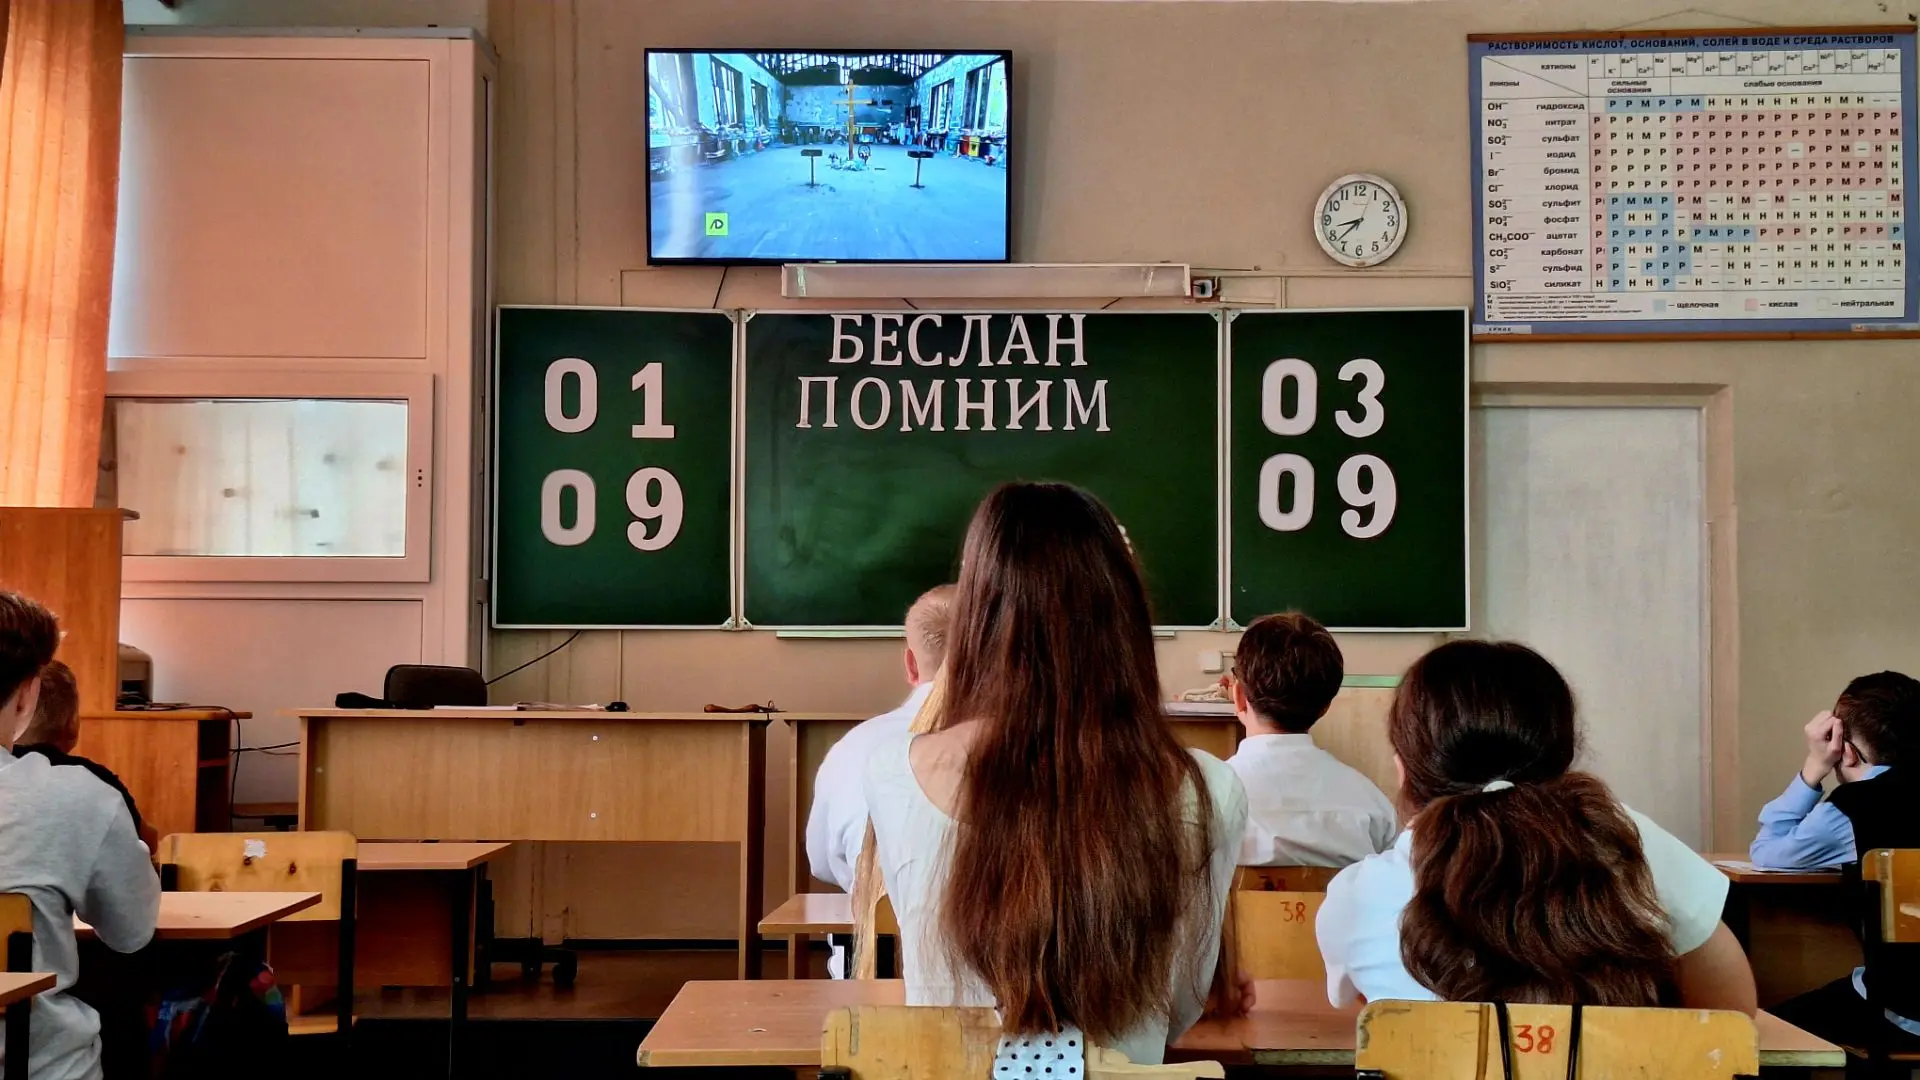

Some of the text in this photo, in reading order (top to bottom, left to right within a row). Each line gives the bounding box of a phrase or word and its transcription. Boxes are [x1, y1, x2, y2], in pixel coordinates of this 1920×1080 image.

[1488, 42, 1579, 50] РАСТВОРИМОСТЬ
[1703, 36, 1738, 46] СОЛЕЙ
[1752, 37, 1780, 46] ВОДЕ
[1784, 37, 1790, 45] И
[1793, 36, 1828, 45] СРЕДА
[1831, 36, 1894, 44] РАСТВОРОВ
[1536, 103, 1585, 111] гидроксид
[1609, 96, 1864, 108] Р Р М Р Р М Н Н Н Н Н Н Н Н М Н
[1593, 112, 1898, 124] Р Р Р Р Р Р Р Р Р Р Р Р Р Р Р Р Р Р Р
[1542, 135, 1580, 144] сульфат
[1594, 128, 1899, 140] Р Р Н М Р Р Р Р Р Р Р Р Р Р Р М Р Р М
[1546, 151, 1576, 159] иодид
[1594, 144, 1898, 157] Р Р Р Р Р Р Р Р Р Р Р Р Р Р М Н Н
[1543, 167, 1580, 175] бромид
[1354, 185, 1366, 196] 12
[1545, 183, 1579, 191] хлорид
[1341, 190, 1349, 200] 11
[1373, 190, 1377, 200] 1
[1329, 201, 1340, 211] 10
[1383, 201, 1390, 212] 2
[1542, 199, 1581, 208] сульфит
[1324, 215, 1331, 226] 9
[1387, 215, 1395, 227] 3
[1544, 215, 1580, 224] фосфат
[1329, 230, 1337, 241] 8
[1381, 231, 1388, 242] 4
[1546, 232, 1578, 240] ацетат
[1341, 241, 1348, 252] 7
[1356, 245, 1363, 256] 6
[1372, 241, 1379, 252] 5
[1541, 248, 1584, 256] карбонат
[1542, 264, 1583, 273] сульфид
[1595, 263, 1603, 271] Р
[1612, 263, 1619, 271] Р
[1646, 262, 1653, 270] Р
[1662, 261, 1670, 270] Р
[1679, 261, 1686, 270] Р
[1727, 261, 1735, 269] Н
[1743, 261, 1751, 269] Н
[1777, 260, 1785, 269] Н
[1794, 260, 1801, 268] Н
[1810, 260, 1818, 268] Н
[1827, 260, 1835, 268] Н
[1844, 259, 1851, 268] Н
[1877, 259, 1884, 267] Н
[1893, 259, 1901, 267] Н
[1544, 280, 1581, 288] силикат
[1840, 300, 1895, 308] нейтральная
[829, 313, 1088, 367] БЕСЛАН
[795, 376, 1110, 432] ПОМНИМ
[1280, 901, 1306, 924] 38
[1513, 1024, 1555, 1054] 38
